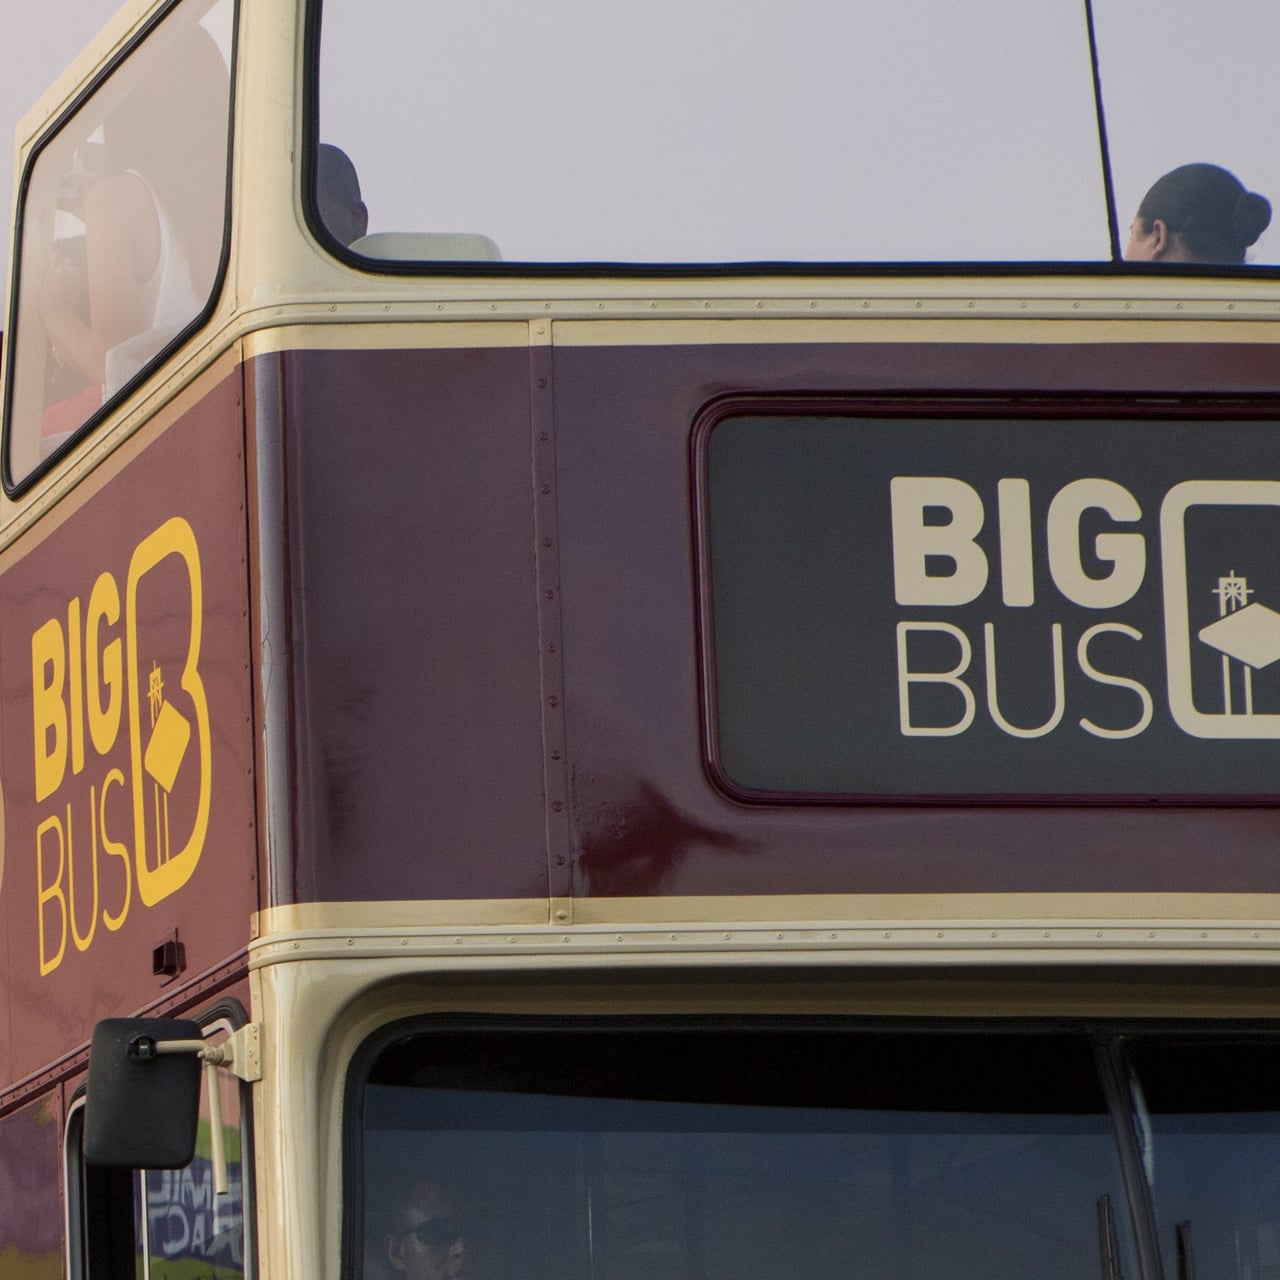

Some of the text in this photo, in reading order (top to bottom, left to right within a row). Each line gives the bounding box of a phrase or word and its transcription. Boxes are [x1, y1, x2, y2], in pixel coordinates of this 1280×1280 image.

[890, 476, 1146, 609] BIG
[32, 571, 123, 803] BIG
[896, 621, 1153, 740] BUS
[37, 768, 132, 976] BUS
